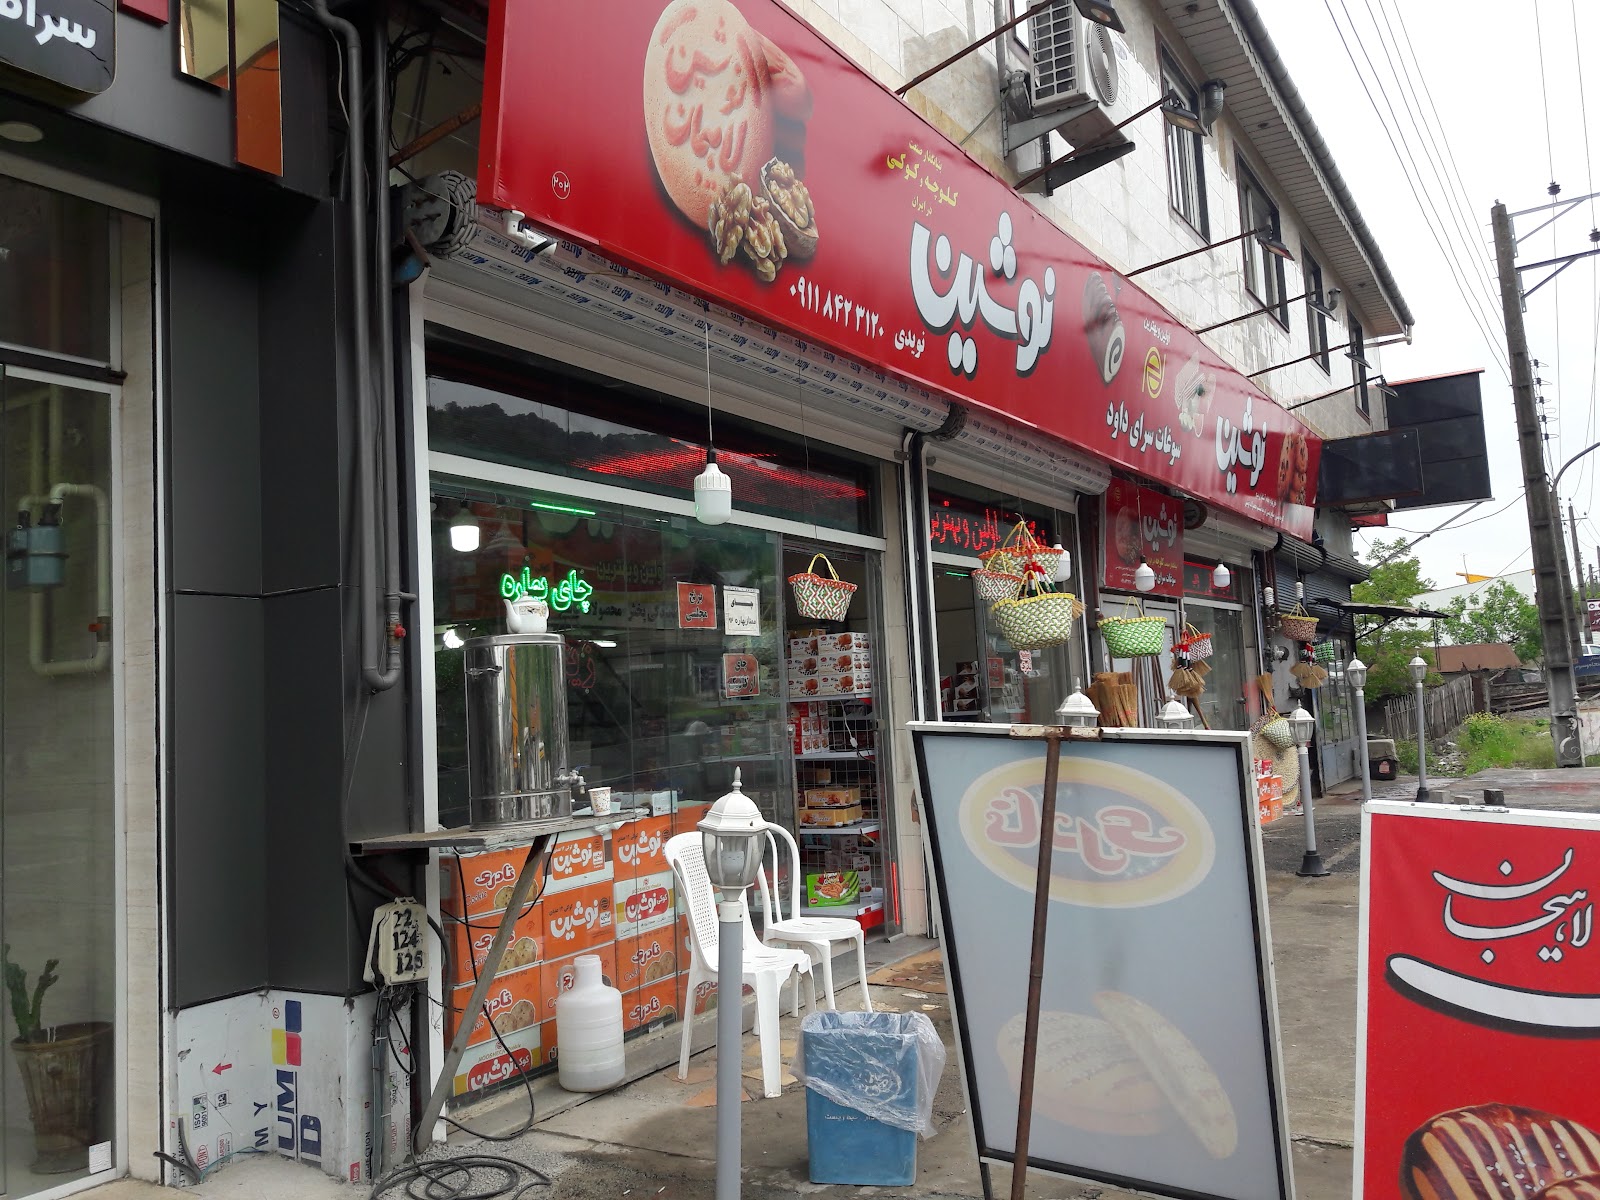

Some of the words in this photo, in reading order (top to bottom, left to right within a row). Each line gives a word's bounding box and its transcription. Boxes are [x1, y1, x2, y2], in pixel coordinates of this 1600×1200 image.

[910, 211, 1056, 378] نوشین
[894, 329, 926, 359] نویدی
[1105, 400, 1129, 439] داود
[1129, 411, 1154, 453] سرای
[1215, 396, 1267, 494] نوشین
[1143, 502, 1178, 552] نوشین
[552, 569, 594, 614] چای
[553, 843, 593, 875] نوشین
[618, 831, 661, 866] نوشین
[550, 899, 599, 941] نوشین
[627, 893, 657, 919] نوشین
[392, 929, 420, 951] 124
